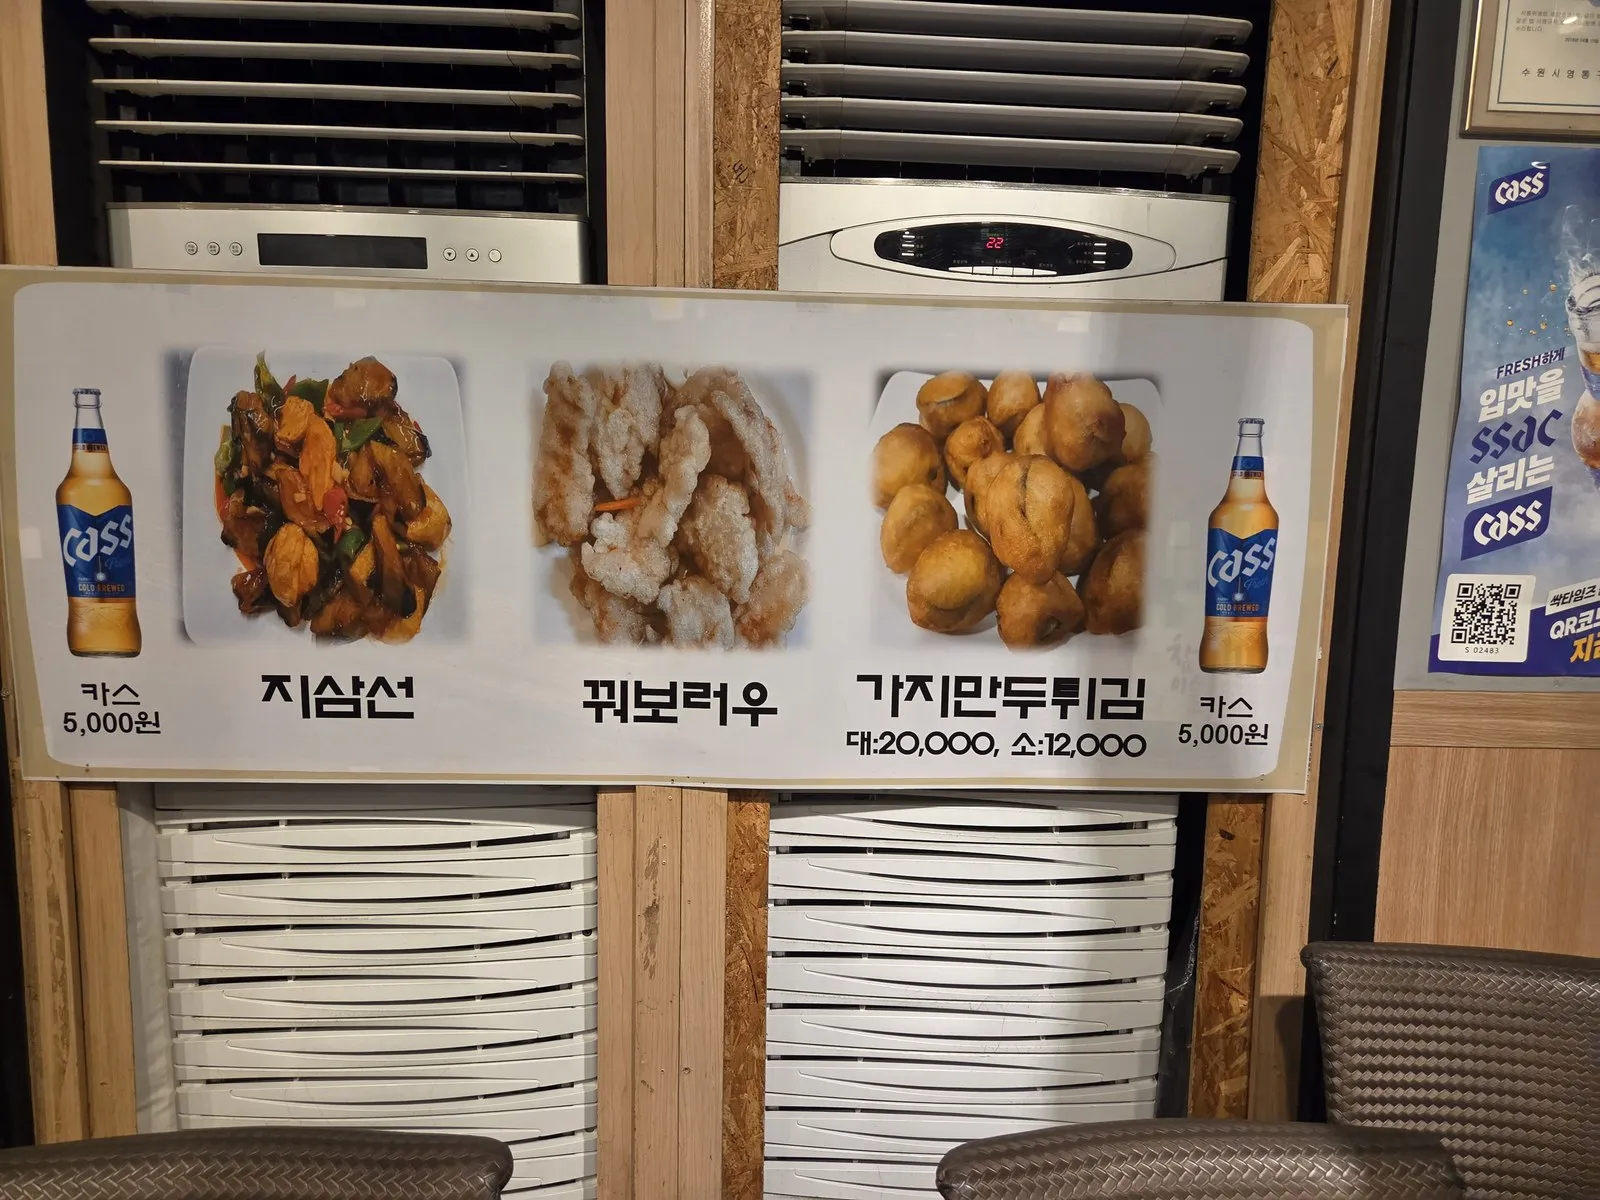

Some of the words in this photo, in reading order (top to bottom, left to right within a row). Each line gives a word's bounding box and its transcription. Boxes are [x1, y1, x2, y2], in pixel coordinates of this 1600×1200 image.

[986, 237, 1004, 248] 22
[1496, 347, 1566, 379] FRESH하게
[1478, 368, 1565, 423] 입맛을
[1467, 454, 1555, 505] 살리는
[78, 583, 95, 592] COLD
[1216, 603, 1231, 612] COLD
[81, 682, 141, 707] 카스
[261, 674, 415, 720] 지삼선
[583, 679, 778, 727] 꿔보러우
[856, 674, 1146, 721] 가지만두튀김
[1200, 695, 1253, 719] 카스
[63, 711, 162, 737] 5,000원
[1178, 723, 1269, 748] 5,000원
[1011, 732, 1147, 759] 소:12,000
